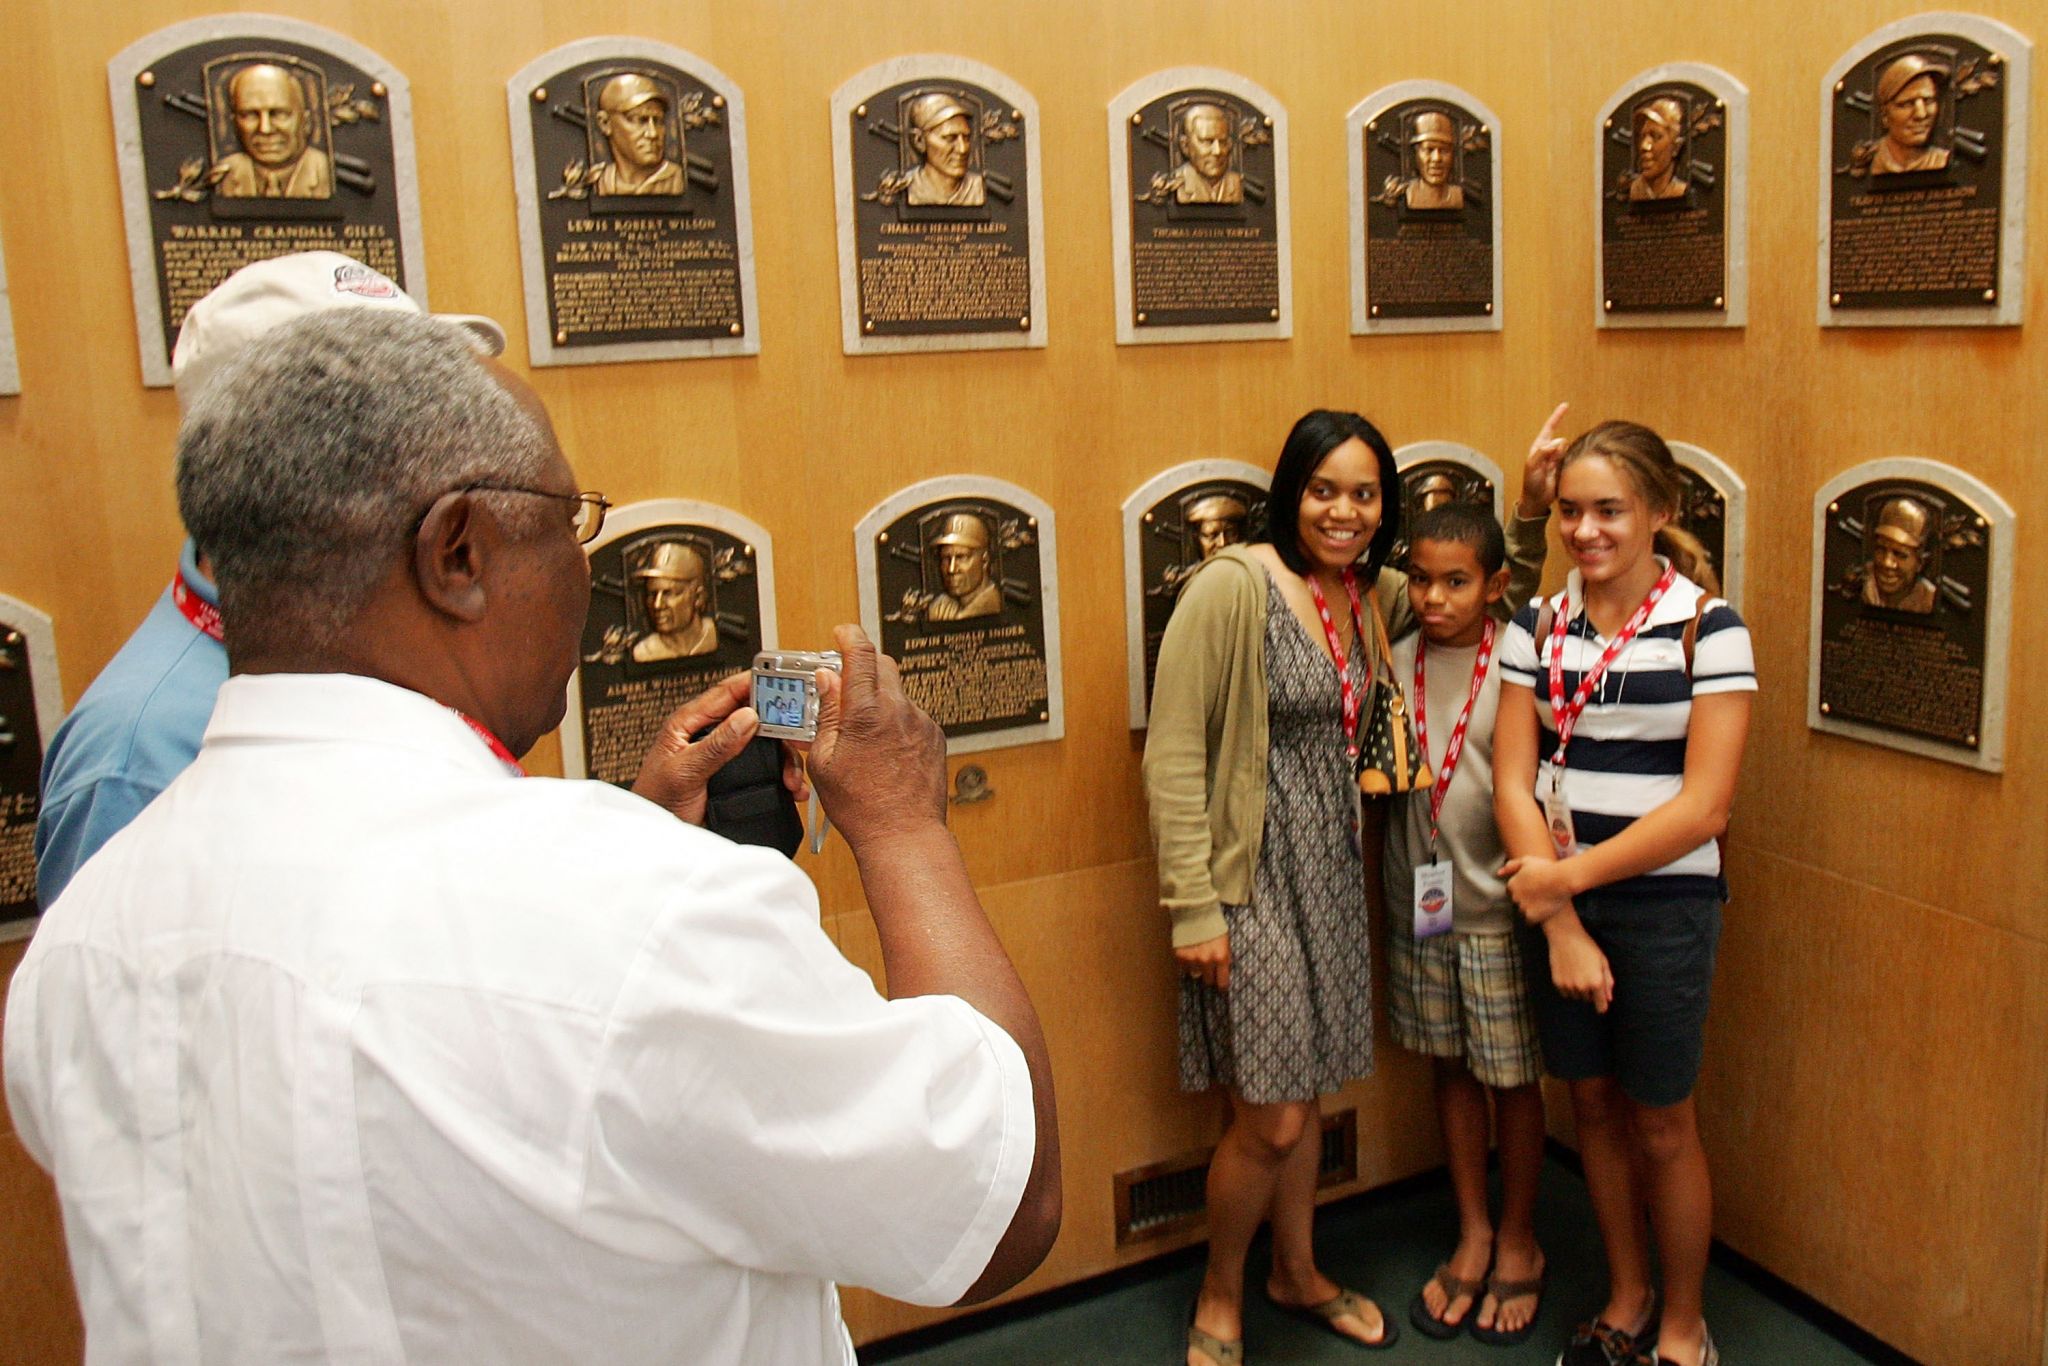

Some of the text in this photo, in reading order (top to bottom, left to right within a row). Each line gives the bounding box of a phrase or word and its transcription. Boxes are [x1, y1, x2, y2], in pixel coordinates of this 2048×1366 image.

[171, 225, 385, 239] WARREN CRANDALL GILES
[567, 218, 717, 233] LEWIS ROBERT WILSON
[929, 223, 973, 235] HERBERT
[976, 223, 1007, 234] KLEIN
[905, 625, 1026, 651] EDWIN DONALD SNIDER
[607, 681, 647, 698] ALBERT
[652, 674, 700, 690] WILLIAM
